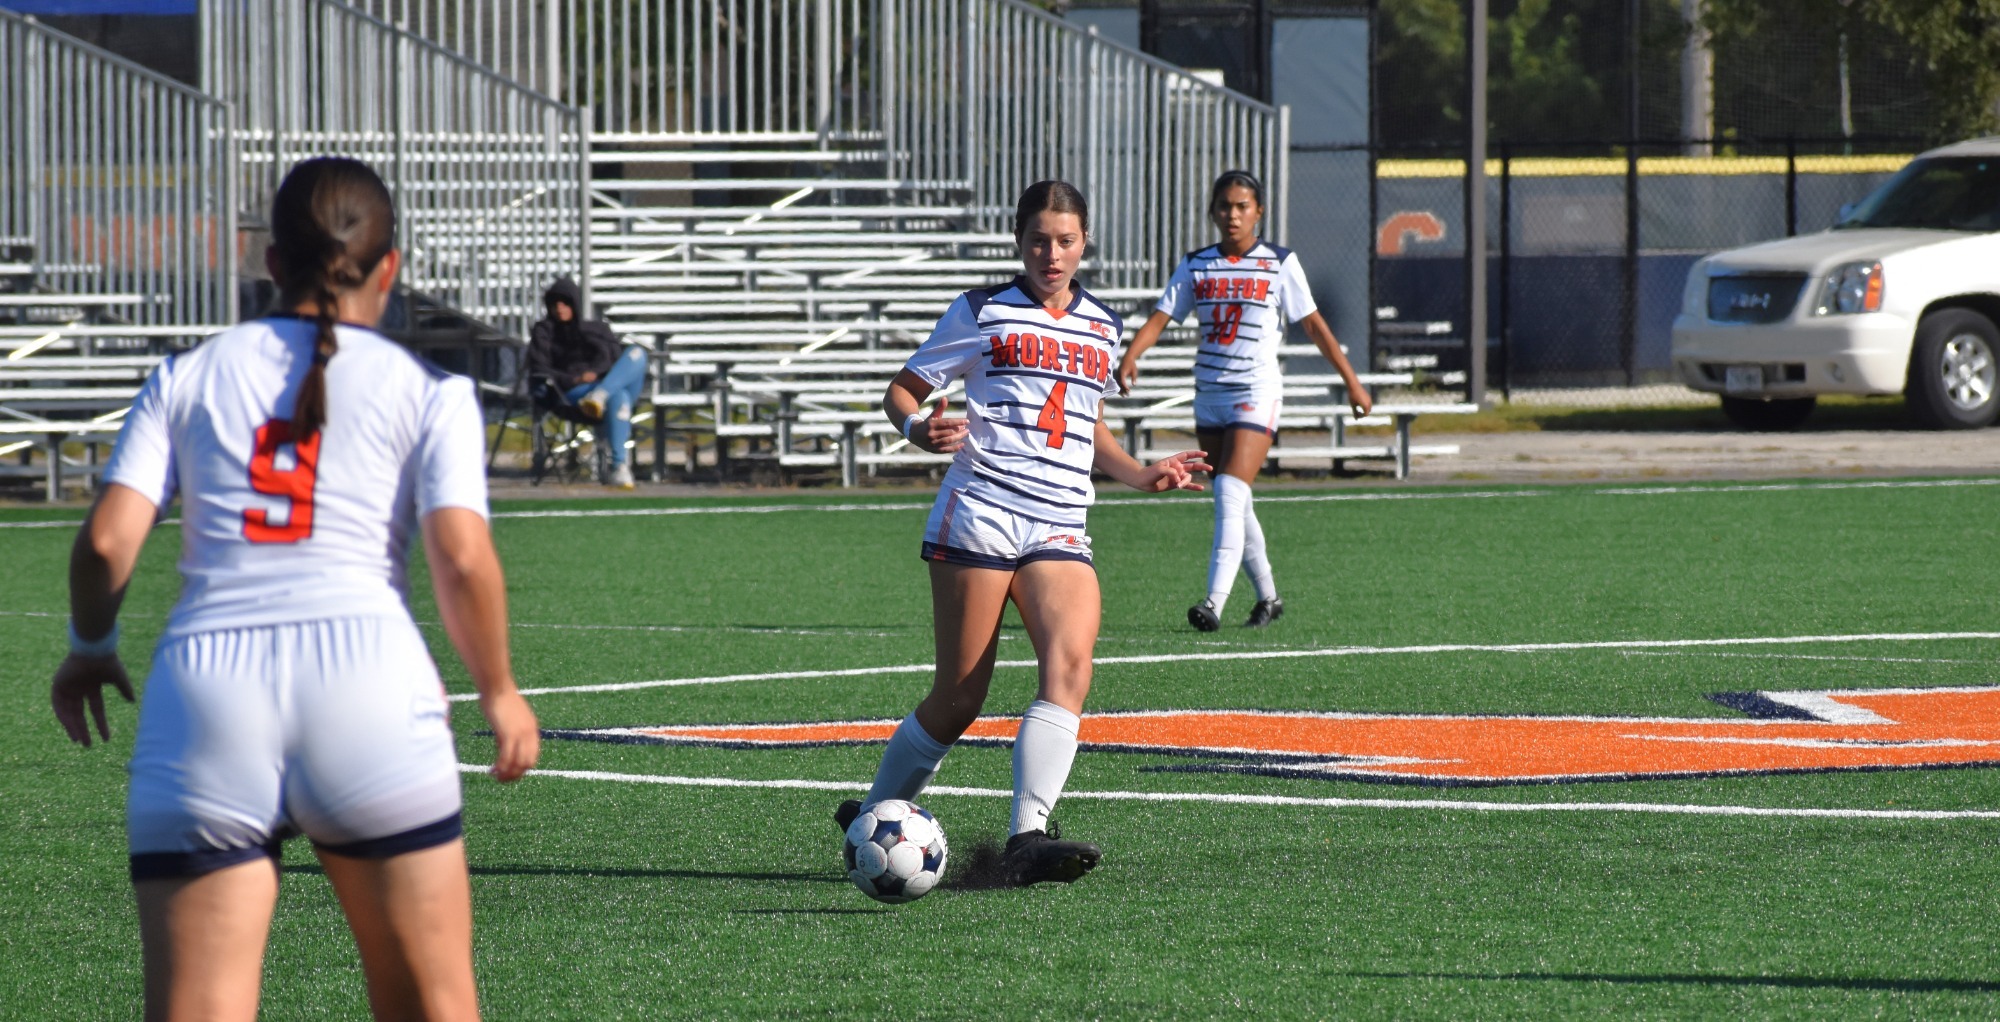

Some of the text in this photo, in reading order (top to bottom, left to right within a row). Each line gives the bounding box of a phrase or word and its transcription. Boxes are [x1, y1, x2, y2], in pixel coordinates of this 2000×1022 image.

[1194, 277, 1270, 302] MORTON
[1089, 320, 1110, 338] MC
[1207, 303, 1243, 346] 10
[990, 333, 1110, 384] MORTON
[1037, 380, 1067, 449] 4
[241, 418, 322, 544] 9
